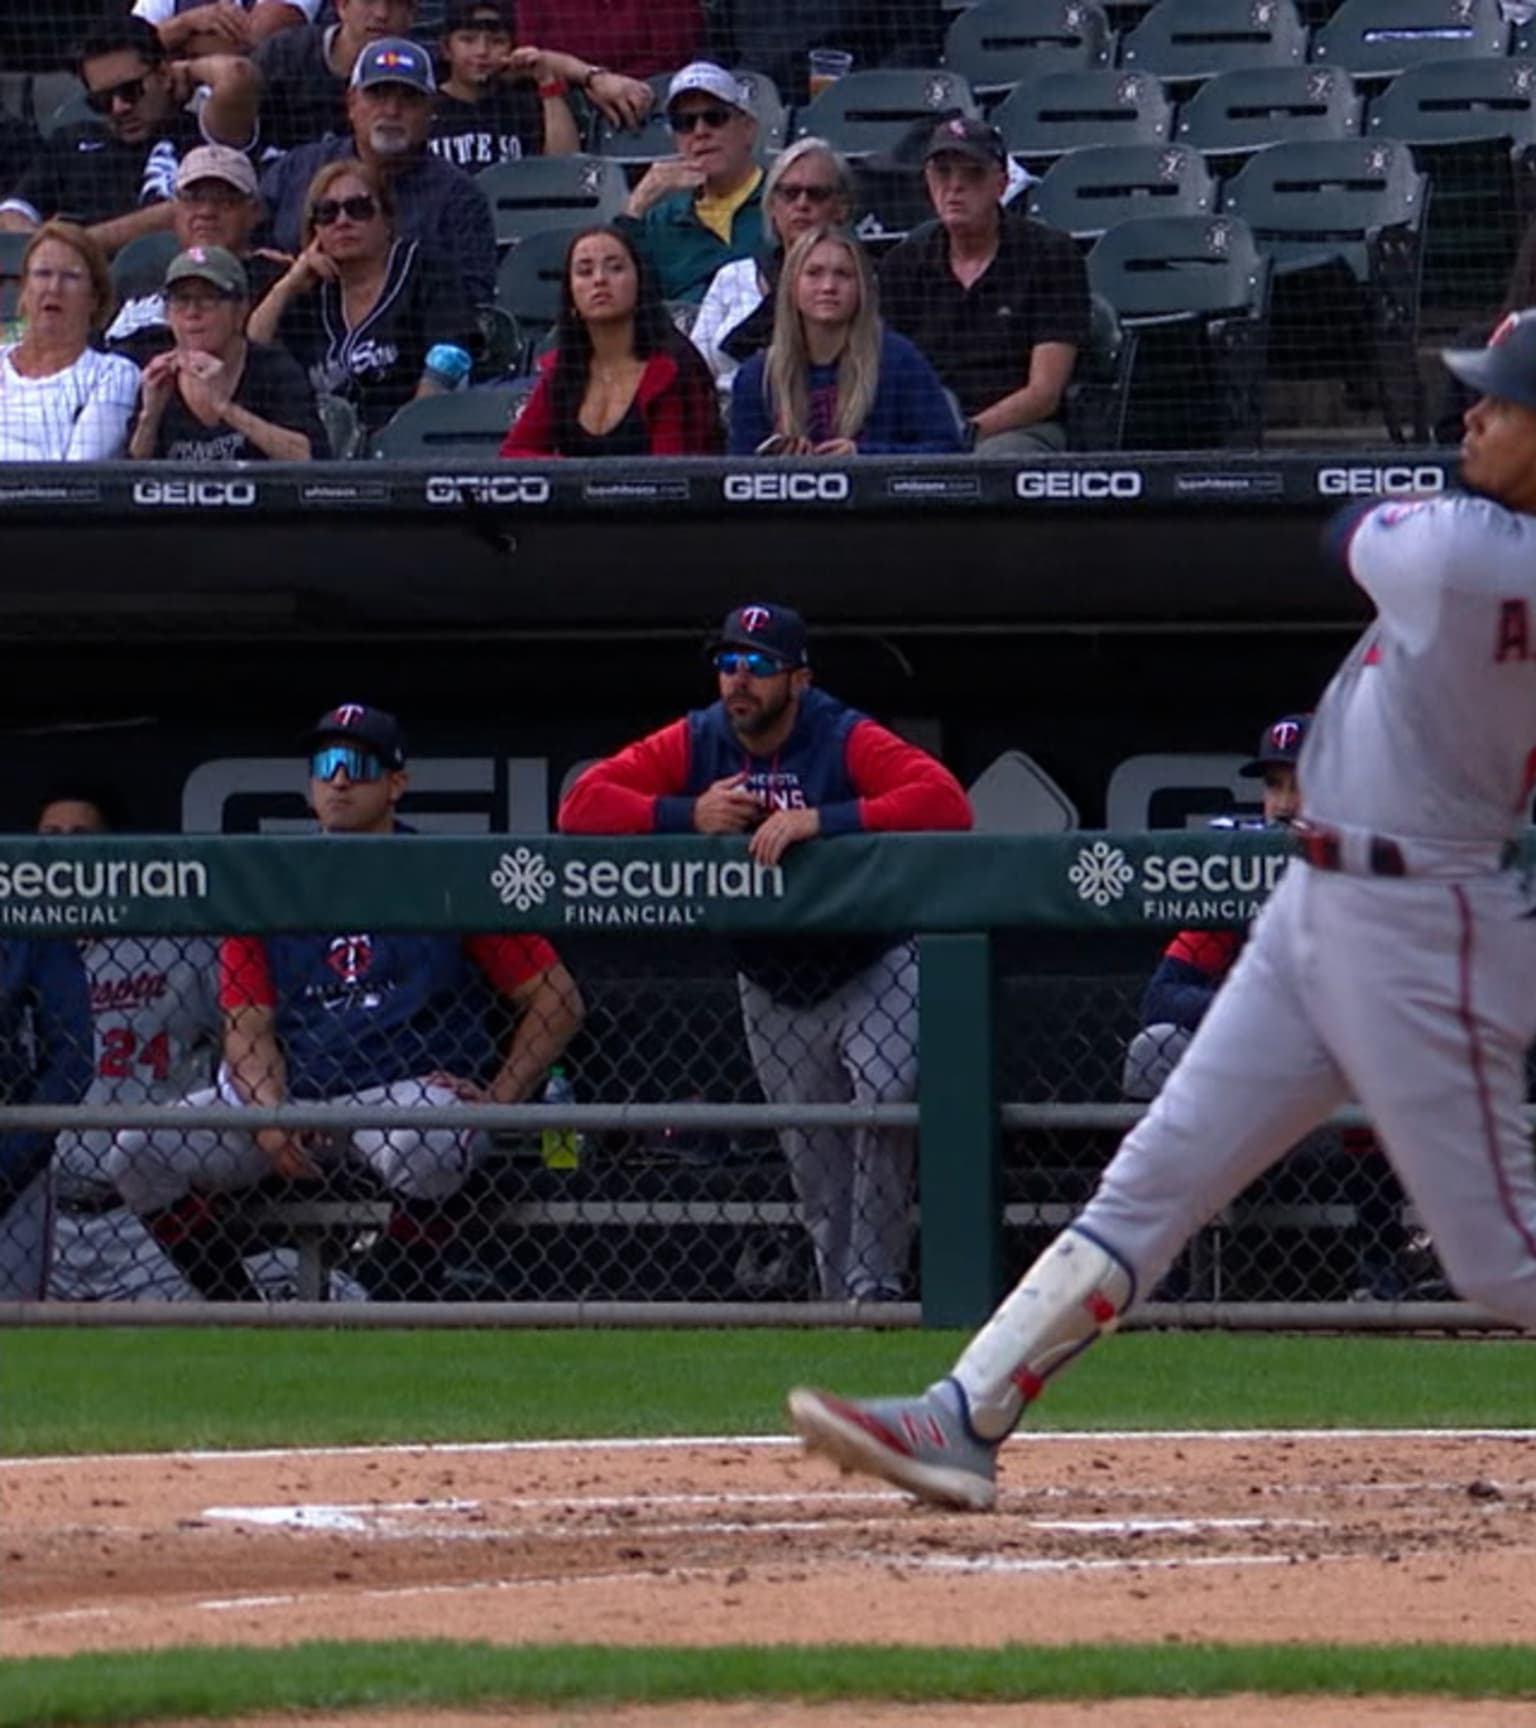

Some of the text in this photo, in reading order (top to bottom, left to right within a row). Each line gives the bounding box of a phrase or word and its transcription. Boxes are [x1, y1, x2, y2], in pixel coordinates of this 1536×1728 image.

[133, 480, 256, 505] GEICO
[723, 473, 848, 500] GEICO
[1016, 471, 1142, 497] GEICO
[1318, 467, 1444, 494] GEICO
[0, 861, 207, 898] securian
[562, 860, 784, 898] securian
[1142, 855, 1286, 892] secur
[564, 905, 704, 924] FINANCIAL
[1144, 901, 1262, 919] FINANCIA
[100, 1030, 169, 1081] 24
